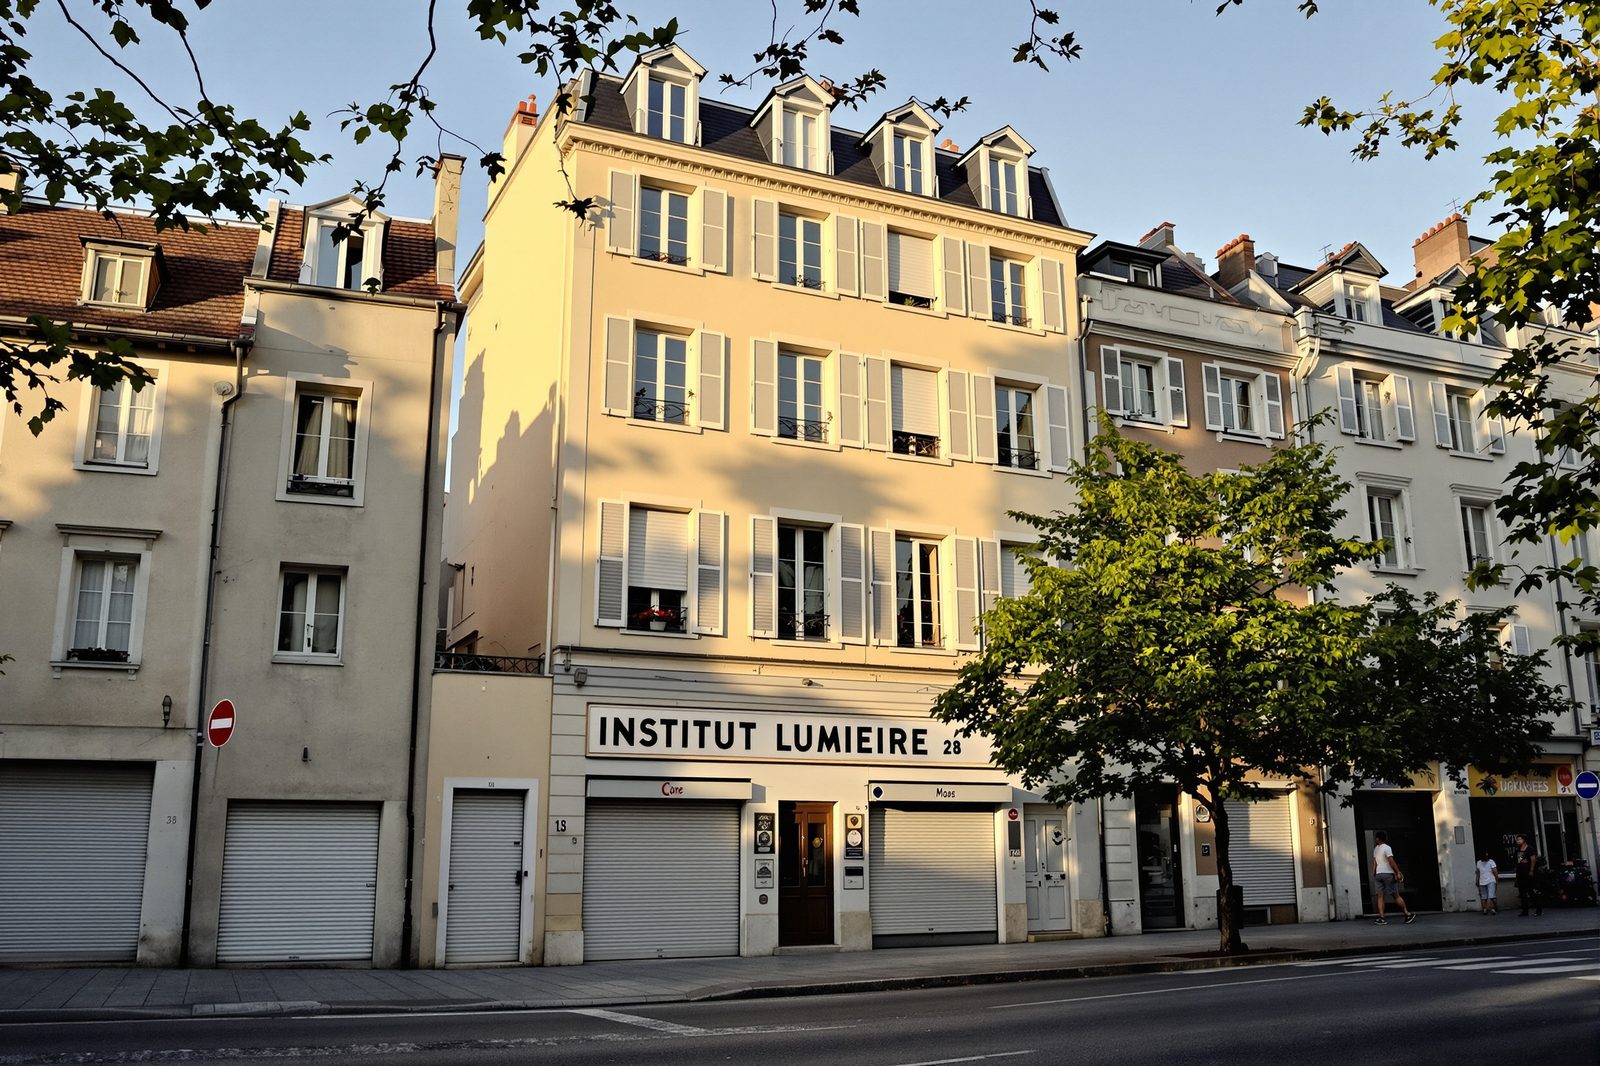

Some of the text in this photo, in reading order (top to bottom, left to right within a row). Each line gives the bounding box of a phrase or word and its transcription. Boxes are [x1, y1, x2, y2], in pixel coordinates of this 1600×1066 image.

[600, 716, 962, 756] INSTITUT LUMIEIRE 28
